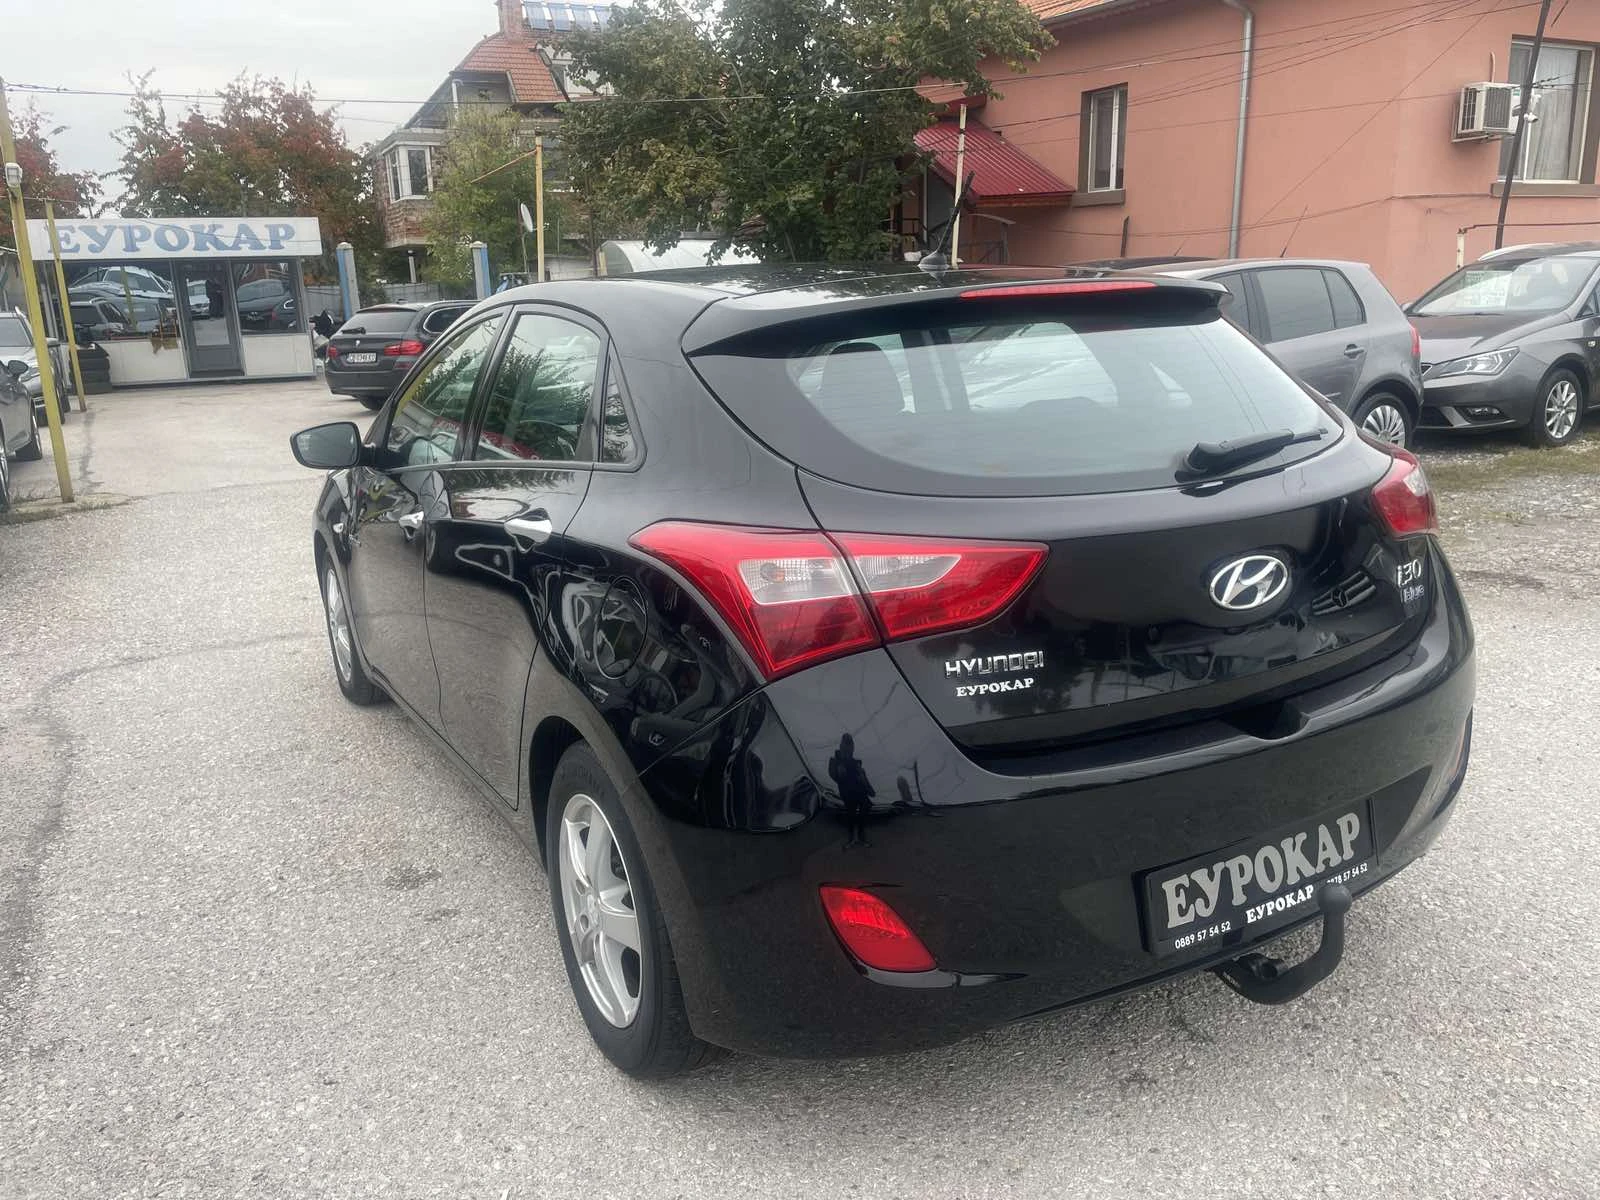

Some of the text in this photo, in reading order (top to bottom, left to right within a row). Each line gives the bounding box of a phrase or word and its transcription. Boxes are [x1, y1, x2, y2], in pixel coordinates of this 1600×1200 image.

[48, 223, 296, 254] ЕУРОКАР
[1397, 559, 1421, 587] i30
[945, 650, 1044, 676] HYUNDAI
[956, 677, 1035, 697] ЕУРОКАР
[1161, 812, 1361, 929] ЕУРОКАР
[1174, 934, 1195, 949] 0889
[1197, 929, 1207, 941] 57
[1208, 925, 1220, 937] 54
[1221, 921, 1231, 932] 52
[1245, 884, 1315, 924] ЕУРОКАР
[1351, 866, 1359, 878] 54
[1360, 862, 1368, 873] 52
